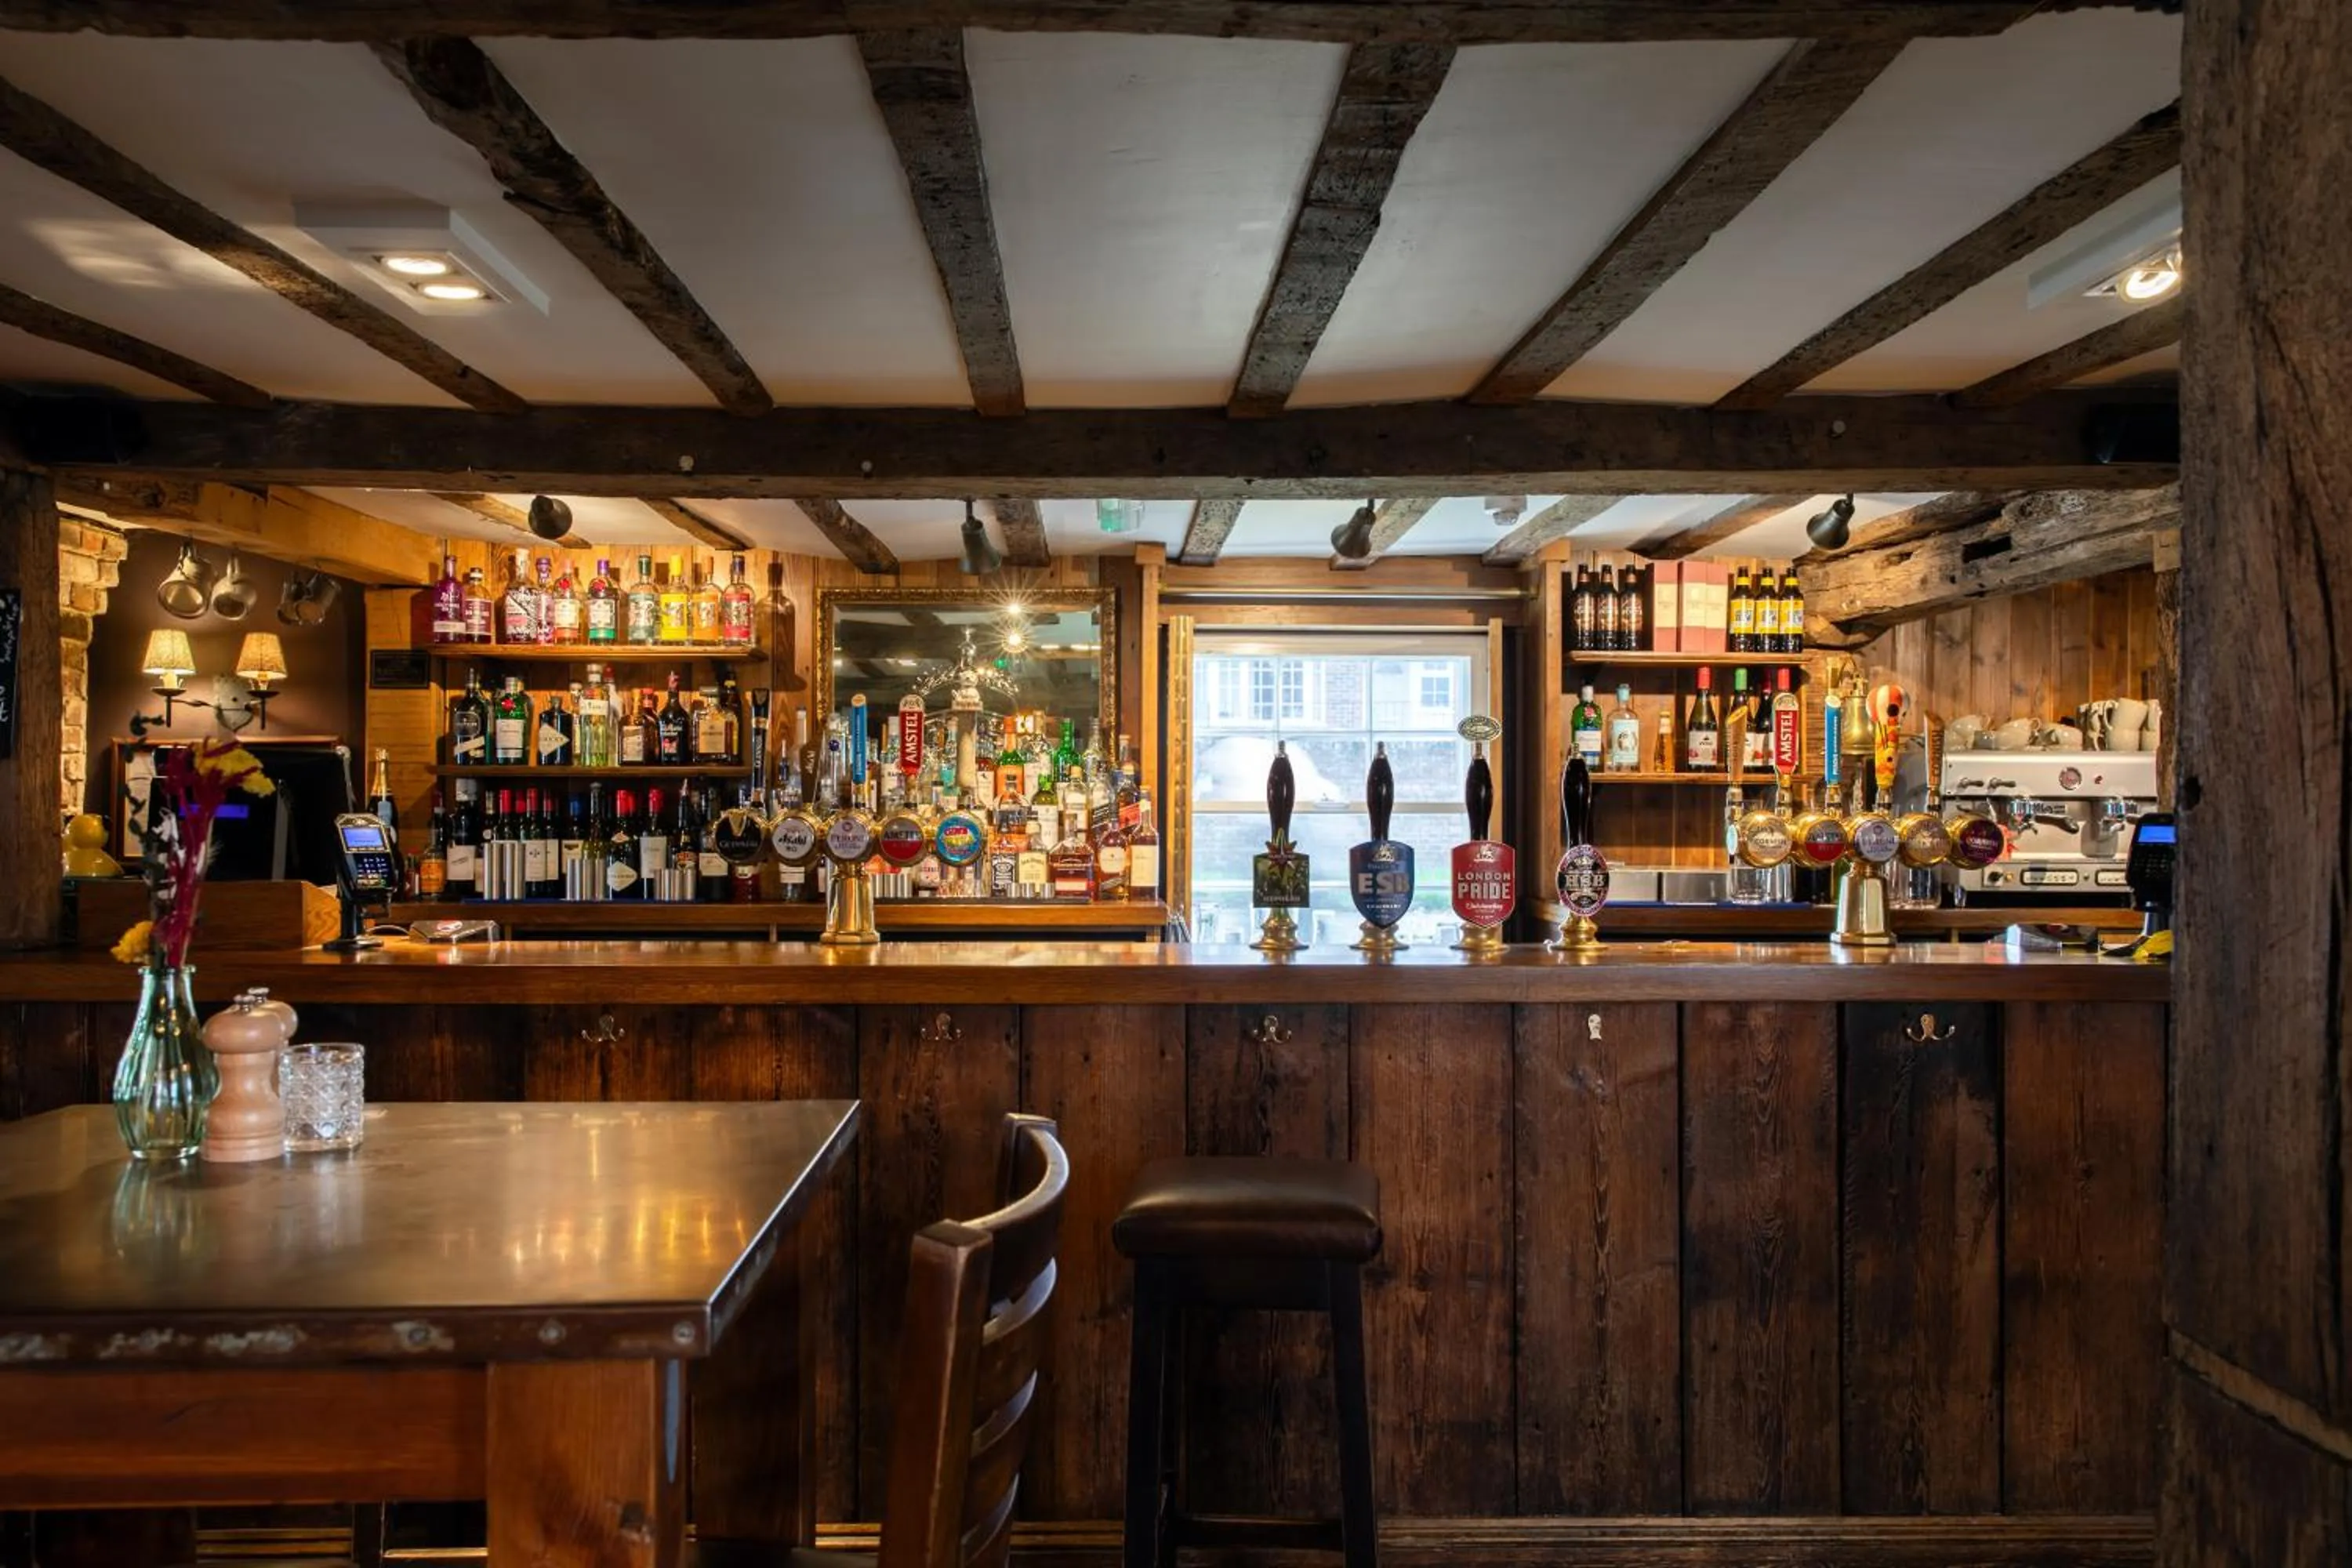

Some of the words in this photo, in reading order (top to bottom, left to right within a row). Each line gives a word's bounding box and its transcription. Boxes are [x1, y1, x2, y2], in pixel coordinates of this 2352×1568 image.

[905, 713, 918, 764] AMSTEL
[1780, 712, 1793, 763] AMSTEL
[779, 833, 807, 845] Asahi
[1358, 872, 1410, 895] ESB
[1457, 882, 1511, 899] PRIDE
